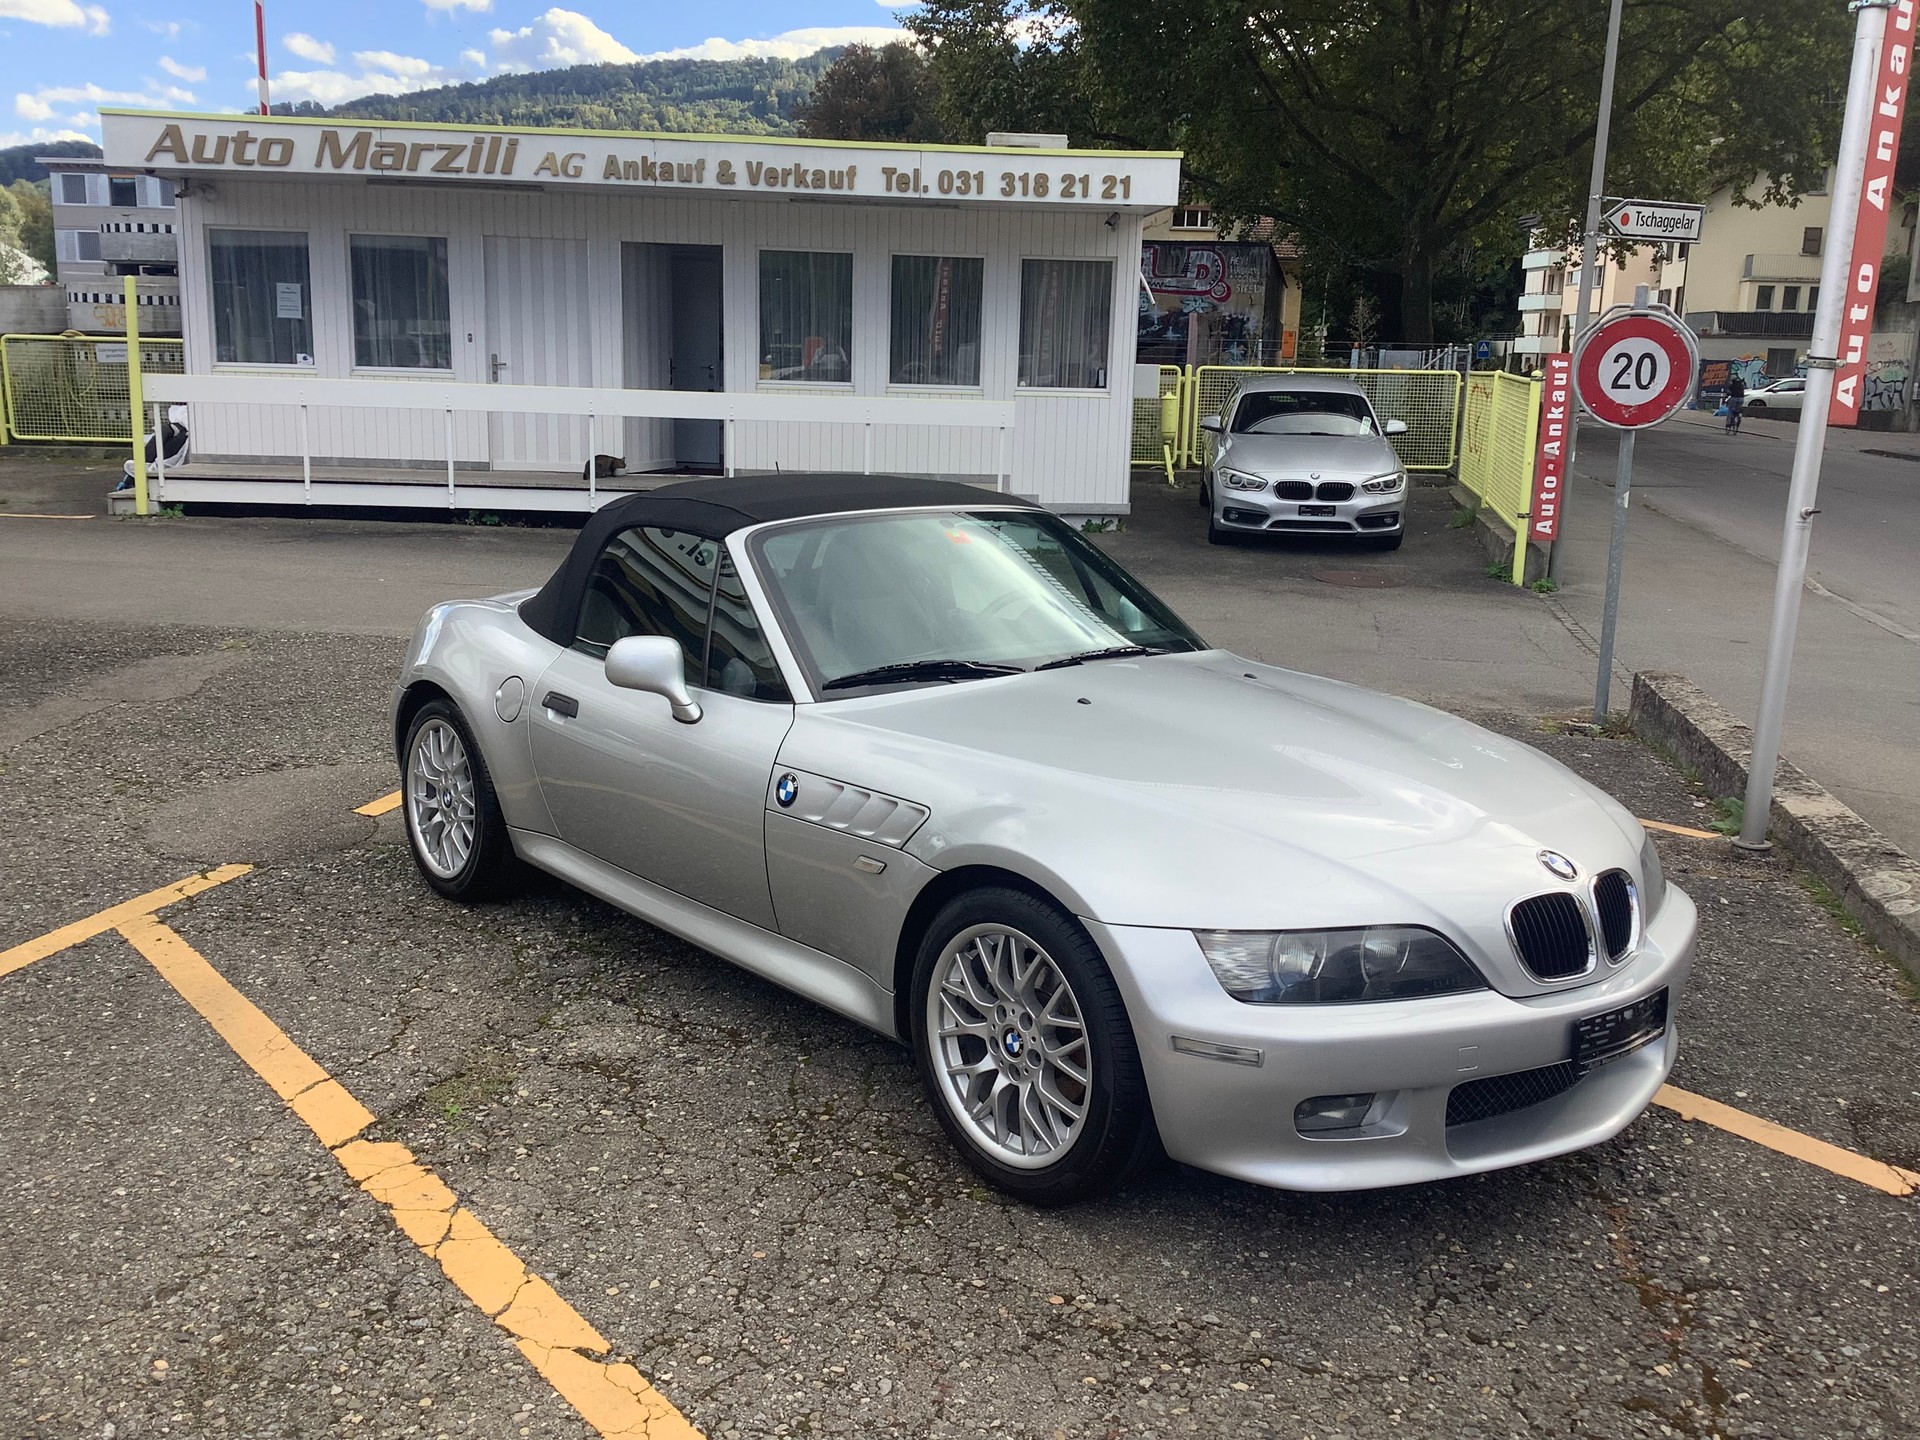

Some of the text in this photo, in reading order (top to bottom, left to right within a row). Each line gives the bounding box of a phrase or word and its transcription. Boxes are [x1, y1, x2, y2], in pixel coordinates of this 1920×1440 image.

[144, 124, 1131, 199] Auto Marzili AG Ankauf & Verkauf Tel. 031 318 21 21
[1635, 211, 1695, 233] Tschaggelar
[1836, 263, 1874, 409] Auto
[1611, 352, 1657, 390] 20
